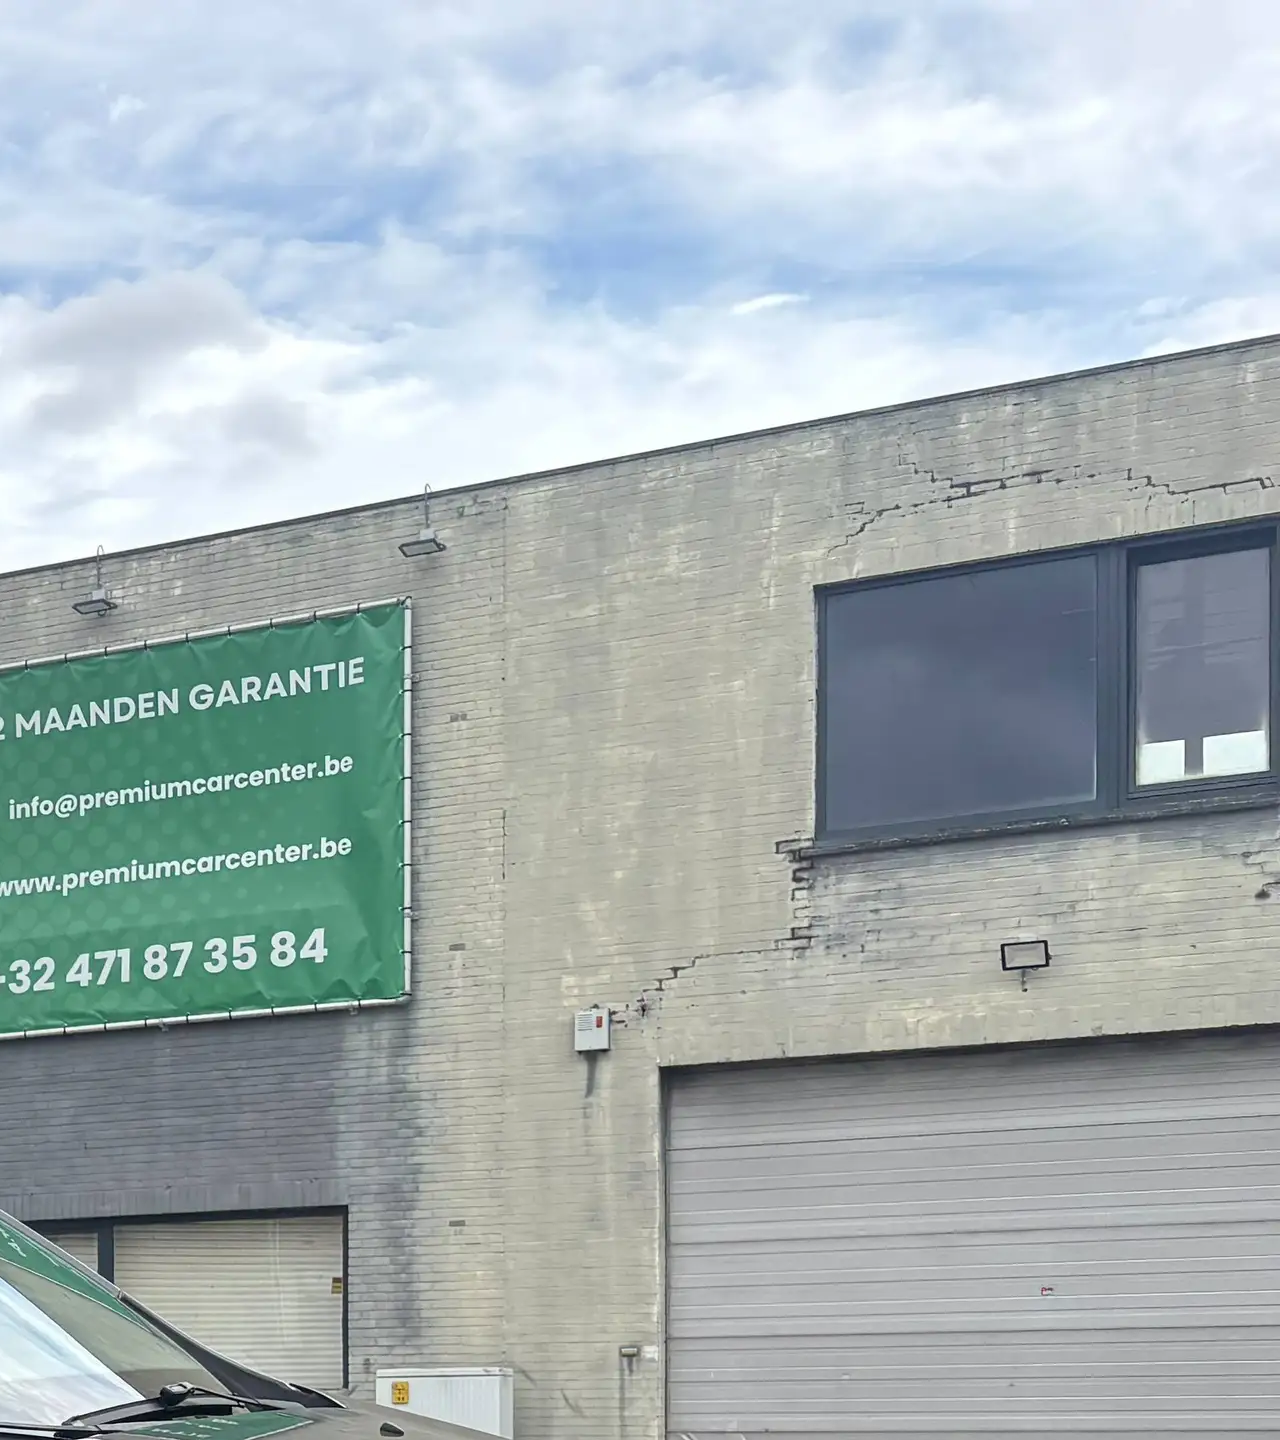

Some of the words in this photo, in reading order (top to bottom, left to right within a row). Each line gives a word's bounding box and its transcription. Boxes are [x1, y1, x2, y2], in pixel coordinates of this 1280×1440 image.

[15, 688, 180, 739] MAANDEN
[188, 656, 366, 712] GARANTIE
[8, 754, 354, 820] info@premiumcarcenter.be
[66, 947, 131, 988] 471
[143, 941, 194, 981] 87
[203, 935, 258, 974] 35
[270, 927, 329, 968] 84
